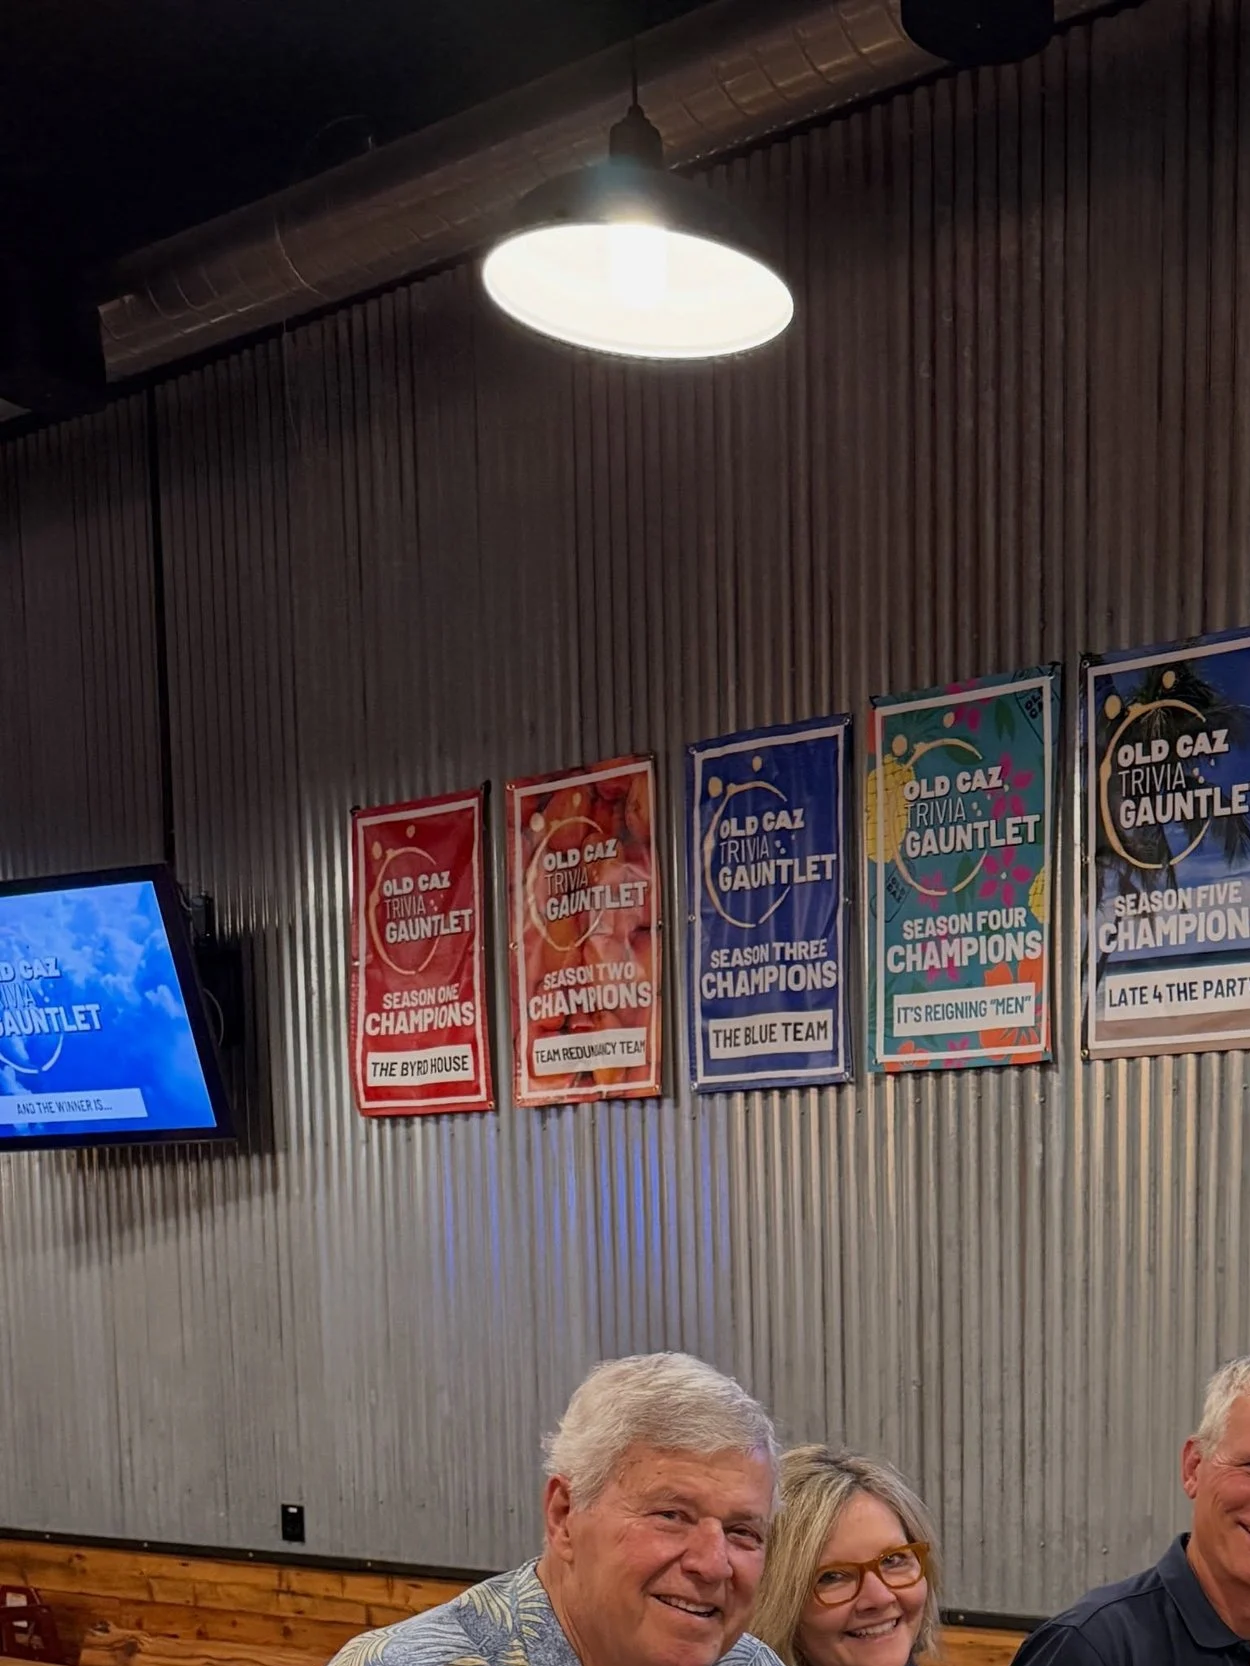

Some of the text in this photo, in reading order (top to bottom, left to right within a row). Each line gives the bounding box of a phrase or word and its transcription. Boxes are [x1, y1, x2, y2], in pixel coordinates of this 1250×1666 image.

[1118, 728, 1230, 769] OLD CAZ
[903, 765, 1003, 801] OLD CAZ
[1118, 762, 1186, 797] TRIVIA
[720, 808, 805, 839] OLD CAZ
[905, 797, 967, 828] TRIVIA
[720, 835, 769, 865] TRIVIA
[905, 813, 1041, 859] GAUNTLET
[543, 838, 618, 871] OLD CAZ
[382, 871, 450, 897] OLD CAZ
[544, 867, 589, 896] TRIVIA
[718, 853, 837, 892] GAUNTLET
[384, 895, 426, 920] TRIVIA
[546, 880, 649, 922] GAUNTLET
[1114, 880, 1243, 917] SEASON FIVE
[385, 909, 474, 944] GAUNTLET
[903, 907, 1027, 941] SEASON FOUR
[710, 938, 828, 969] SEASON THREE
[886, 929, 1043, 974] CHAMPIONS
[20, 957, 61, 981] CAZ
[543, 961, 636, 991] SEASON TWO
[701, 960, 838, 1000] CHAMPIONS
[0, 982, 36, 1010] IVIA
[382, 983, 460, 1010] SEASON ONE
[528, 981, 653, 1022] CHAMPIONS
[897, 995, 1032, 1024] IT'S REIGNING "MEN"
[1109, 986, 1149, 1008] LATE
[1152, 984, 1163, 1004] 4
[1166, 982, 1199, 1003] THE
[0, 1003, 101, 1037] AUNTLET
[365, 1001, 475, 1036] CHAMPIONS
[713, 1020, 828, 1048] THE BLUE TEAM
[371, 1055, 469, 1077] THE BYRD HOUSE
[535, 1048, 561, 1064] TEAM
[17, 1103, 36, 1115] AND
[36, 1101, 56, 1114] THE
[56, 1099, 92, 1113] WINNER
